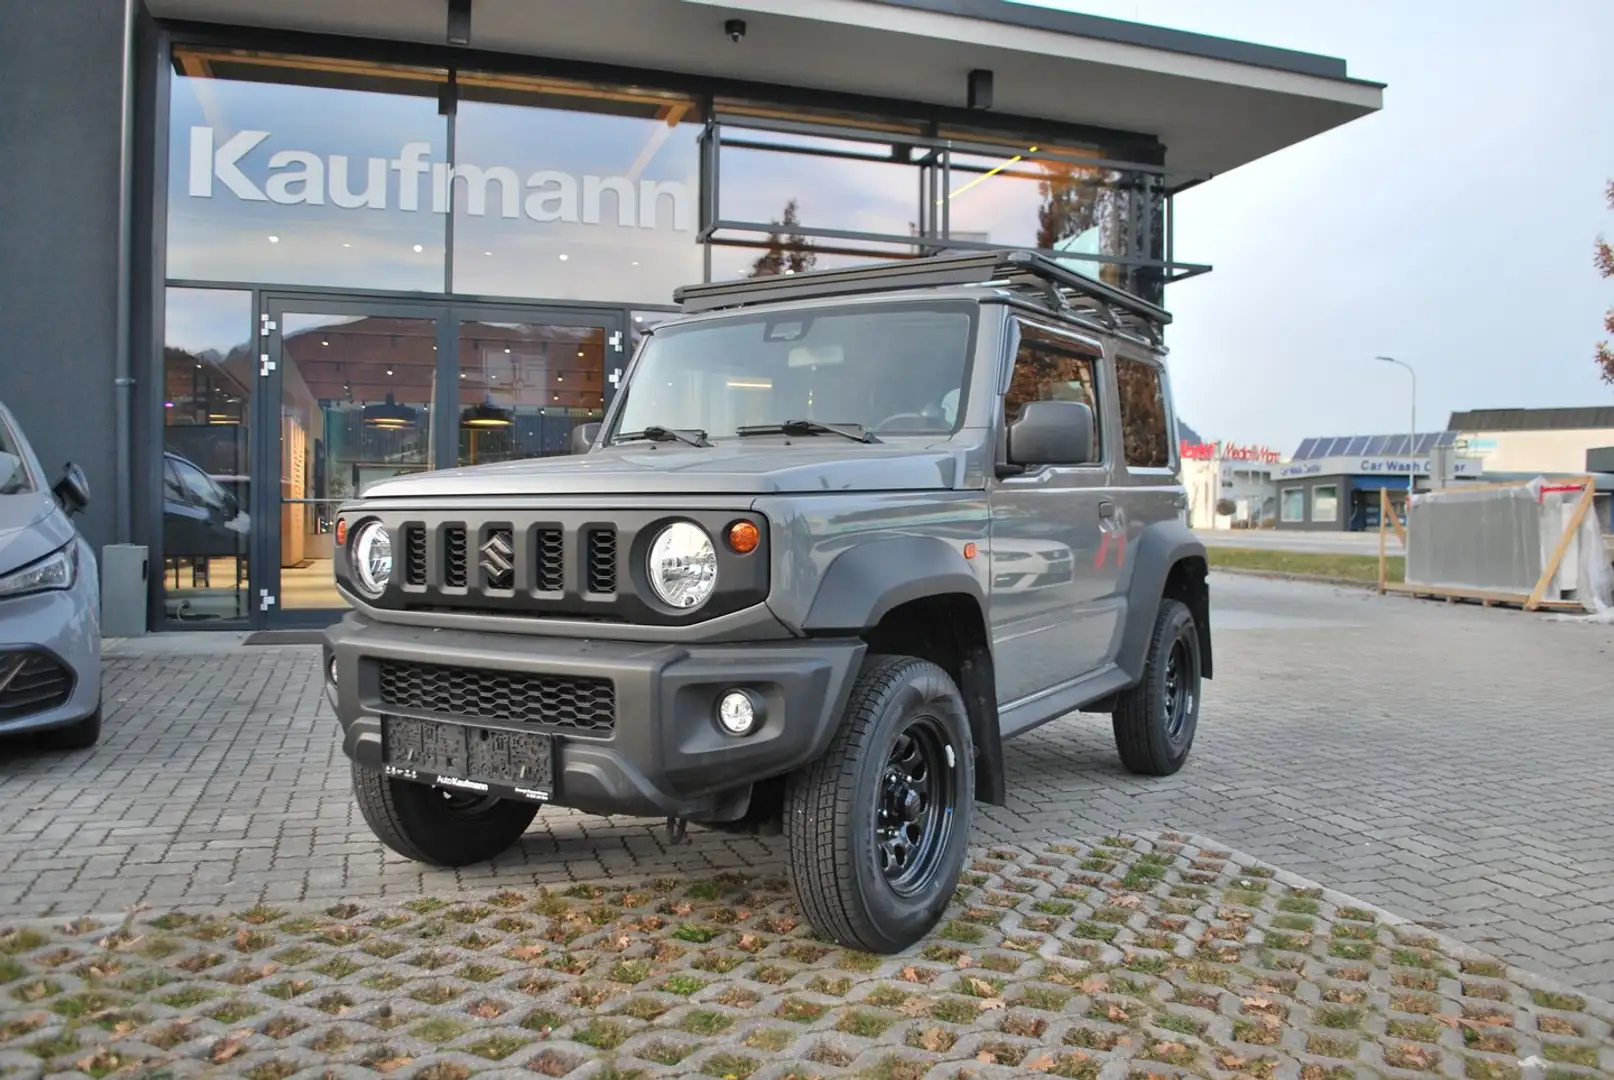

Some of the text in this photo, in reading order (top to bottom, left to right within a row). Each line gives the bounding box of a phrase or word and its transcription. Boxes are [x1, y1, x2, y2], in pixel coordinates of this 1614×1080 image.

[189, 126, 688, 231] Kaufmann
[1361, 460, 1465, 471] Car Wash Cer
